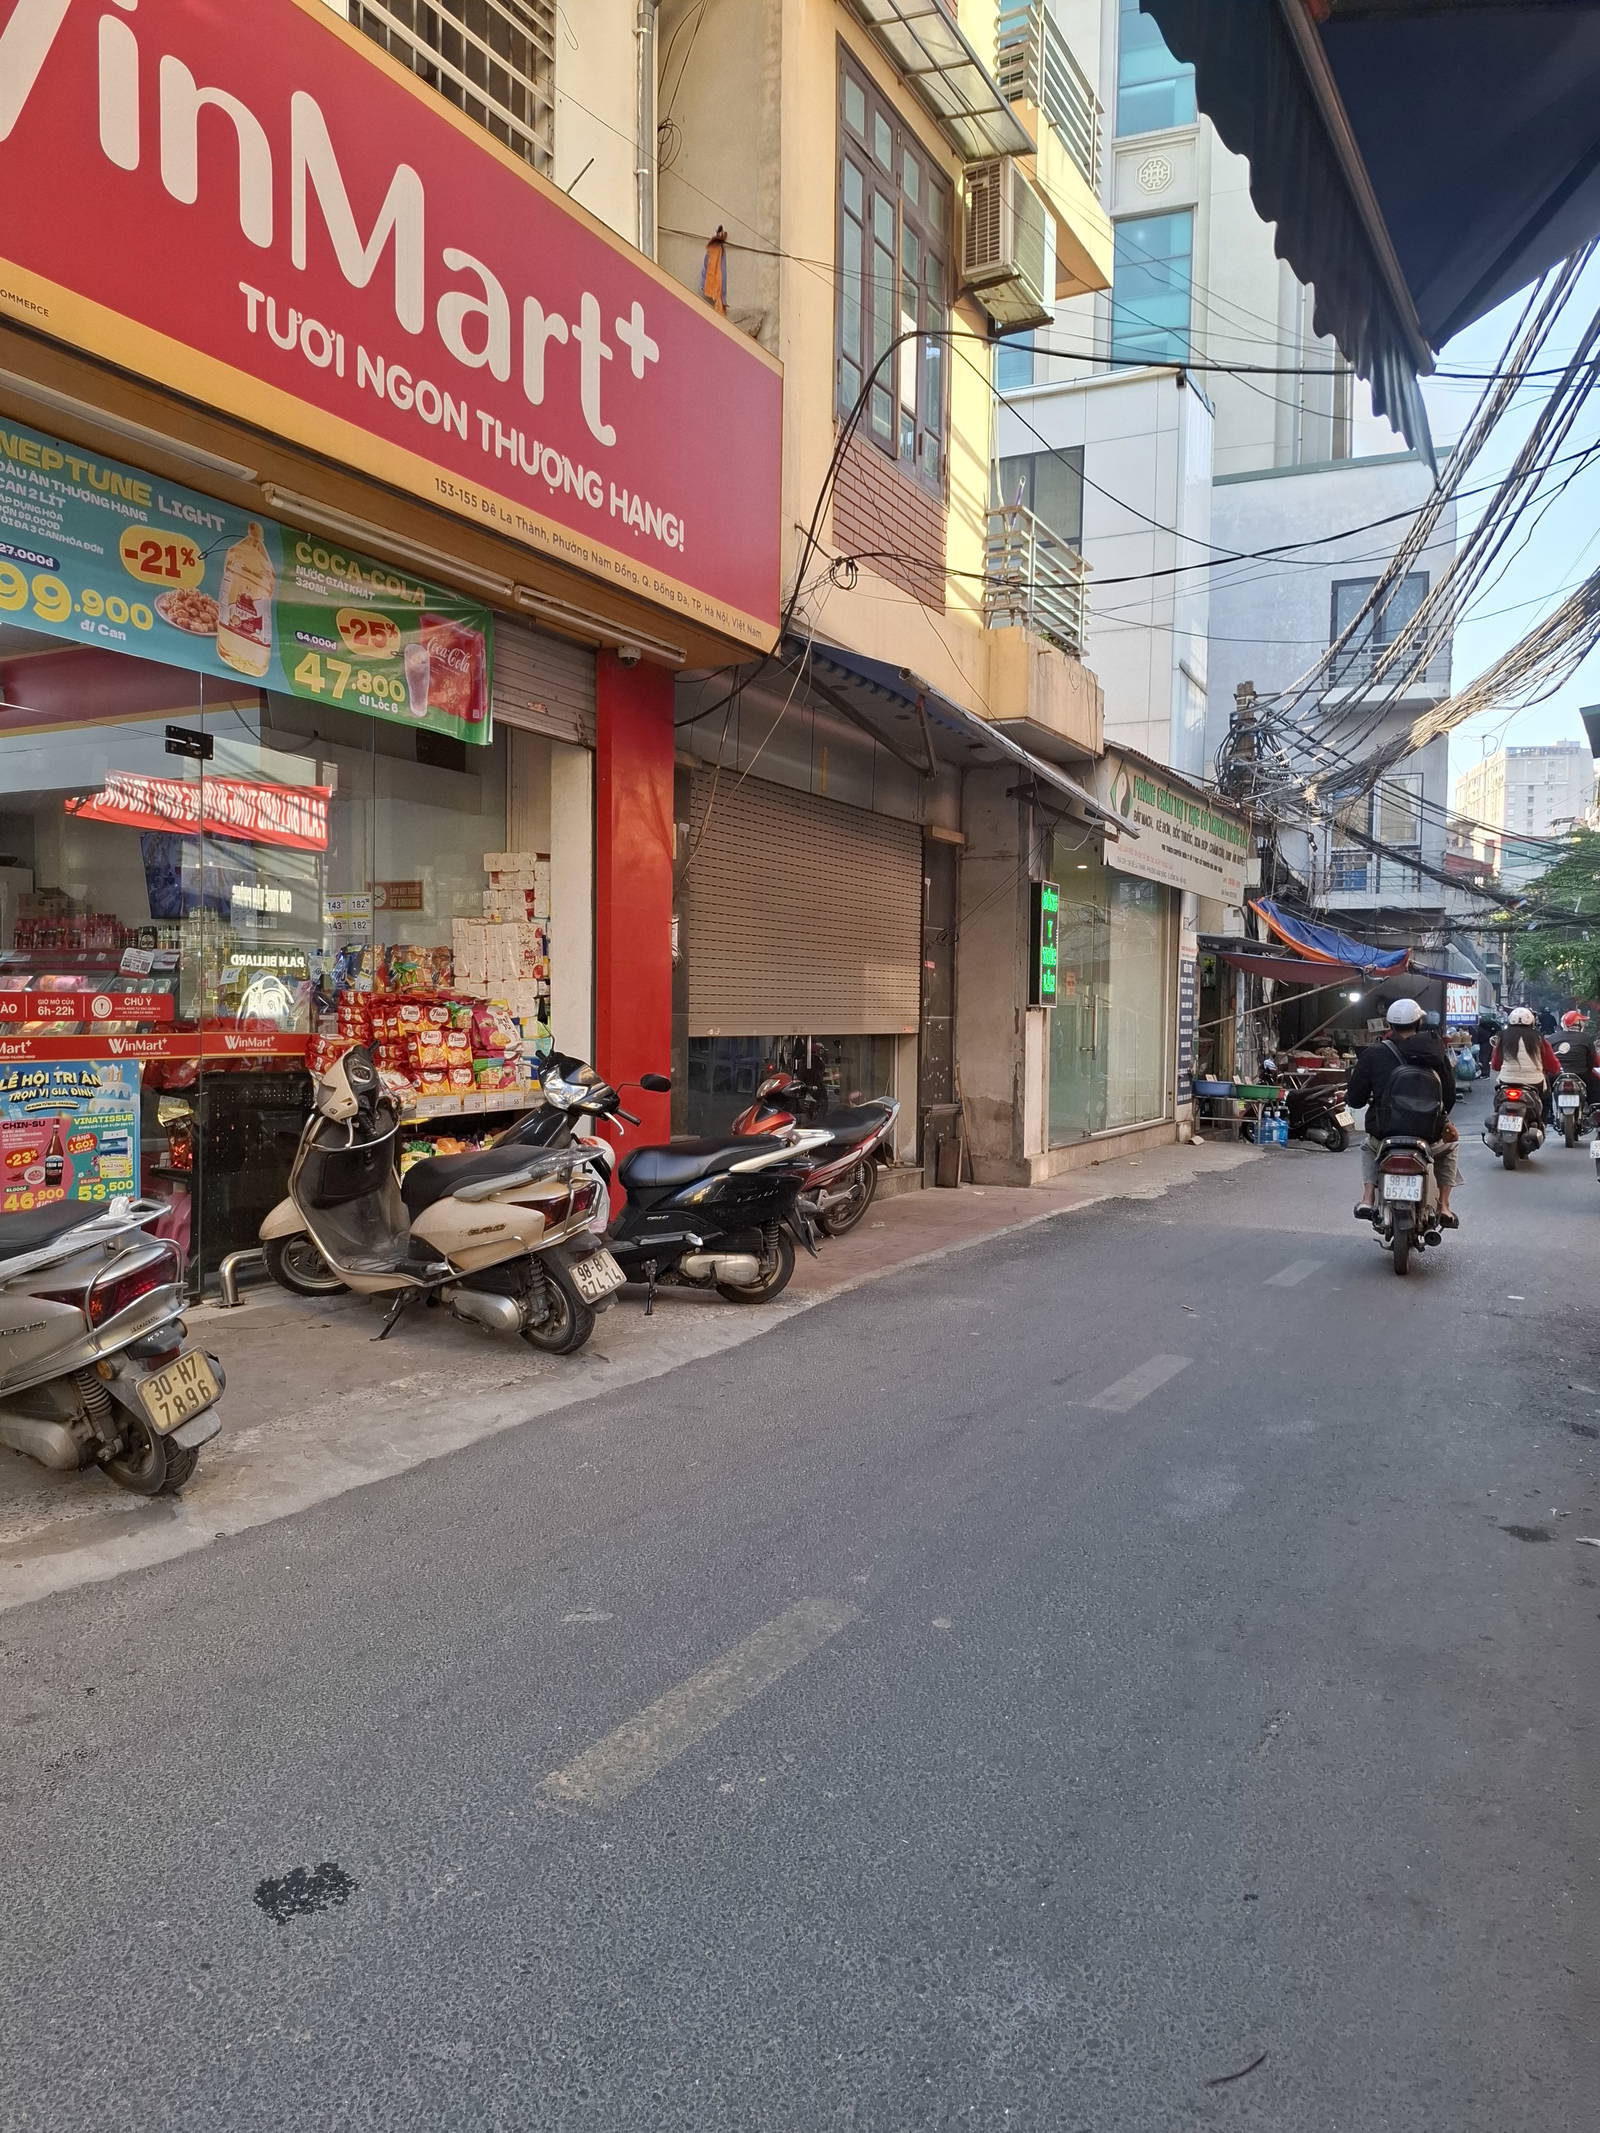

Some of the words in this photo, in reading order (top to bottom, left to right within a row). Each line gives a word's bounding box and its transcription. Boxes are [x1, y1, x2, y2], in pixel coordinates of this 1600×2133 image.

[238, 281, 345, 378] TƯƠI
[356, 345, 467, 440] NGON
[476, 409, 603, 508] THƯỢNG
[610, 482, 685, 552] HẠNG!
[0, 430, 153, 508] NEPTUNE
[158, 494, 226, 531] LIGHT
[28, 488, 38, 500] 2
[435, 478, 478, 508] 153-155
[481, 499, 496, 517] Đê
[500, 508, 513, 525] La
[515, 515, 550, 543] Thành,
[553, 533, 588, 561] Phường
[591, 552, 612, 569] Nam
[641, 575, 651, 588] Q.
[124, 540, 196, 579] -21%
[295, 541, 426, 607] COCA-COLA
[98, 625, 126, 641] Can
[340, 618, 399, 649] -25%
[294, 651, 405, 702] 47.800
[391, 703, 398, 713] 6
[37, 1006, 75, 1016] 6h-22h
[108, 1037, 168, 1054] WinMart+
[224, 1035, 275, 1050] WinMart+
[51, 1087, 70, 1096] GIA
[2, 1120, 46, 1130] CHIN-SU
[74, 1114, 134, 1125] VINATISSUE
[6, 1149, 39, 1167] -23%
[4, 1188, 65, 1212] 46.900
[78, 1180, 134, 1202] 53.500
[577, 1254, 609, 1281] 98-B1
[149, 1355, 198, 1402] 30-H7
[158, 1378, 212, 1426] 7896
